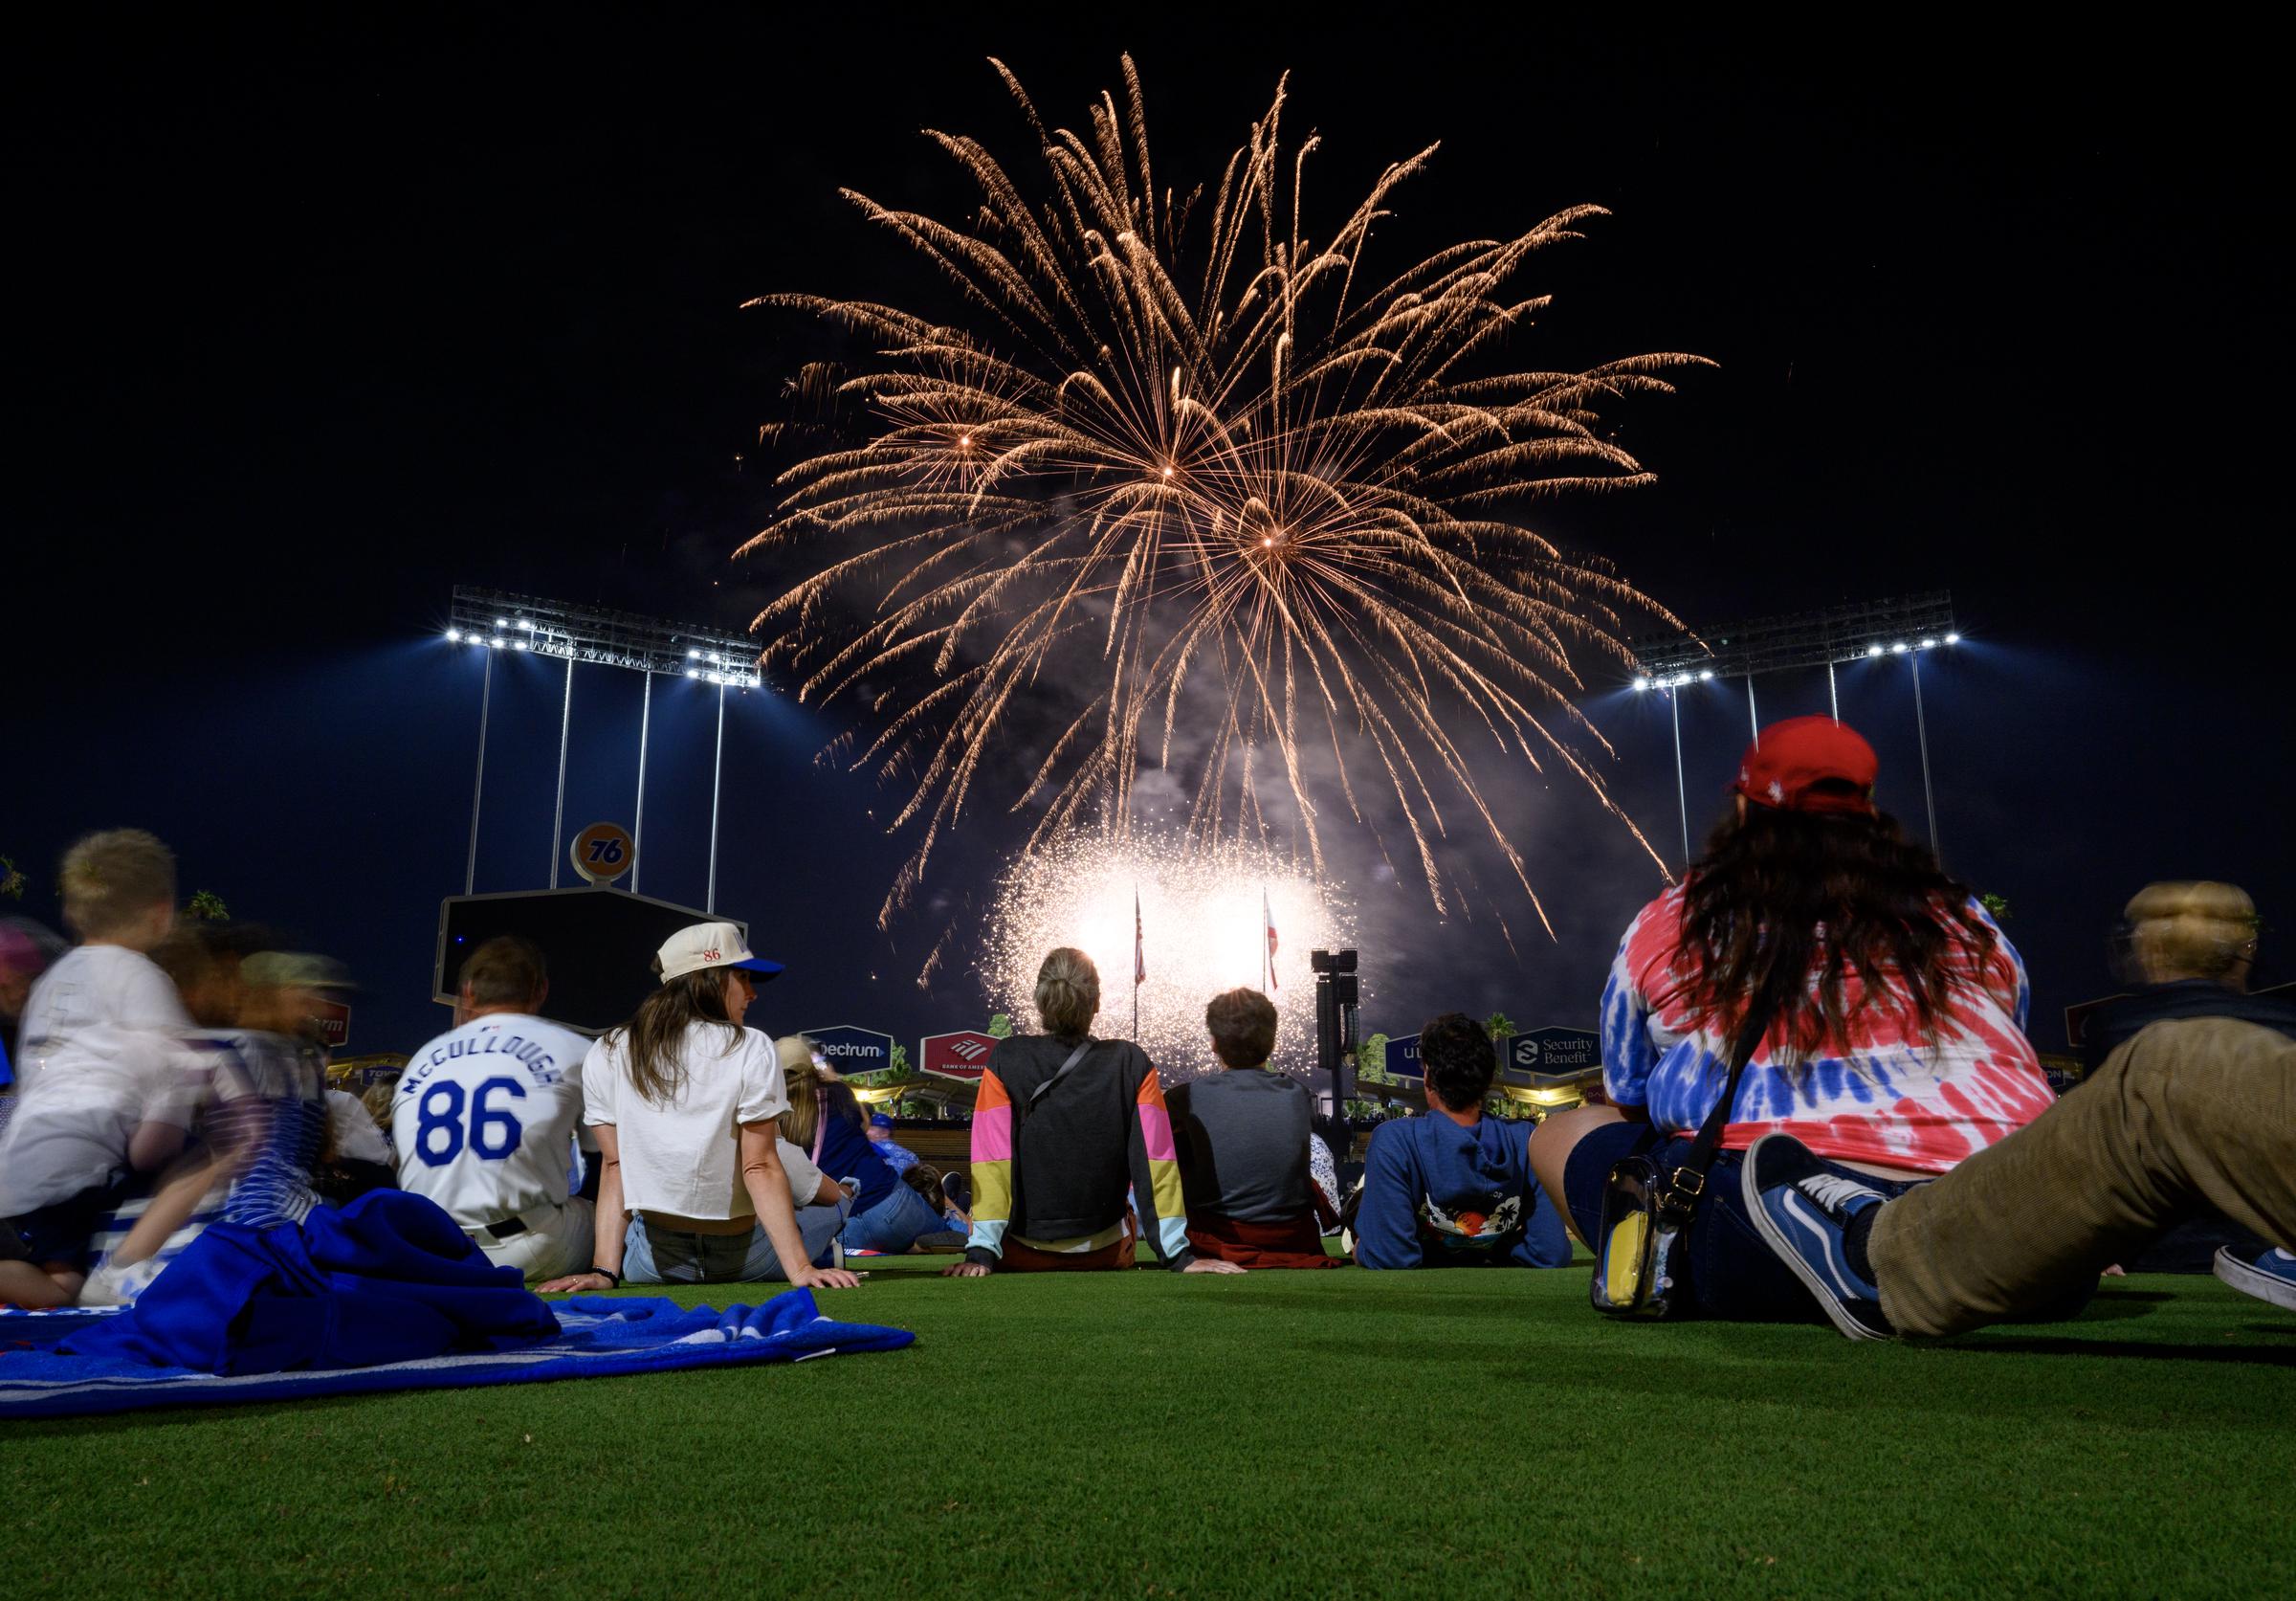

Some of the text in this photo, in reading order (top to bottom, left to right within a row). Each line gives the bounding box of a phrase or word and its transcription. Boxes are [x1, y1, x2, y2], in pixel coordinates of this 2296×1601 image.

[587, 837, 624, 865] 76
[703, 947, 721, 963] 86
[821, 1042, 879, 1056] pectrum
[1543, 1038, 1593, 1052] Security
[1545, 1052, 1588, 1064] Benefit
[415, 1076, 526, 1167] 86
